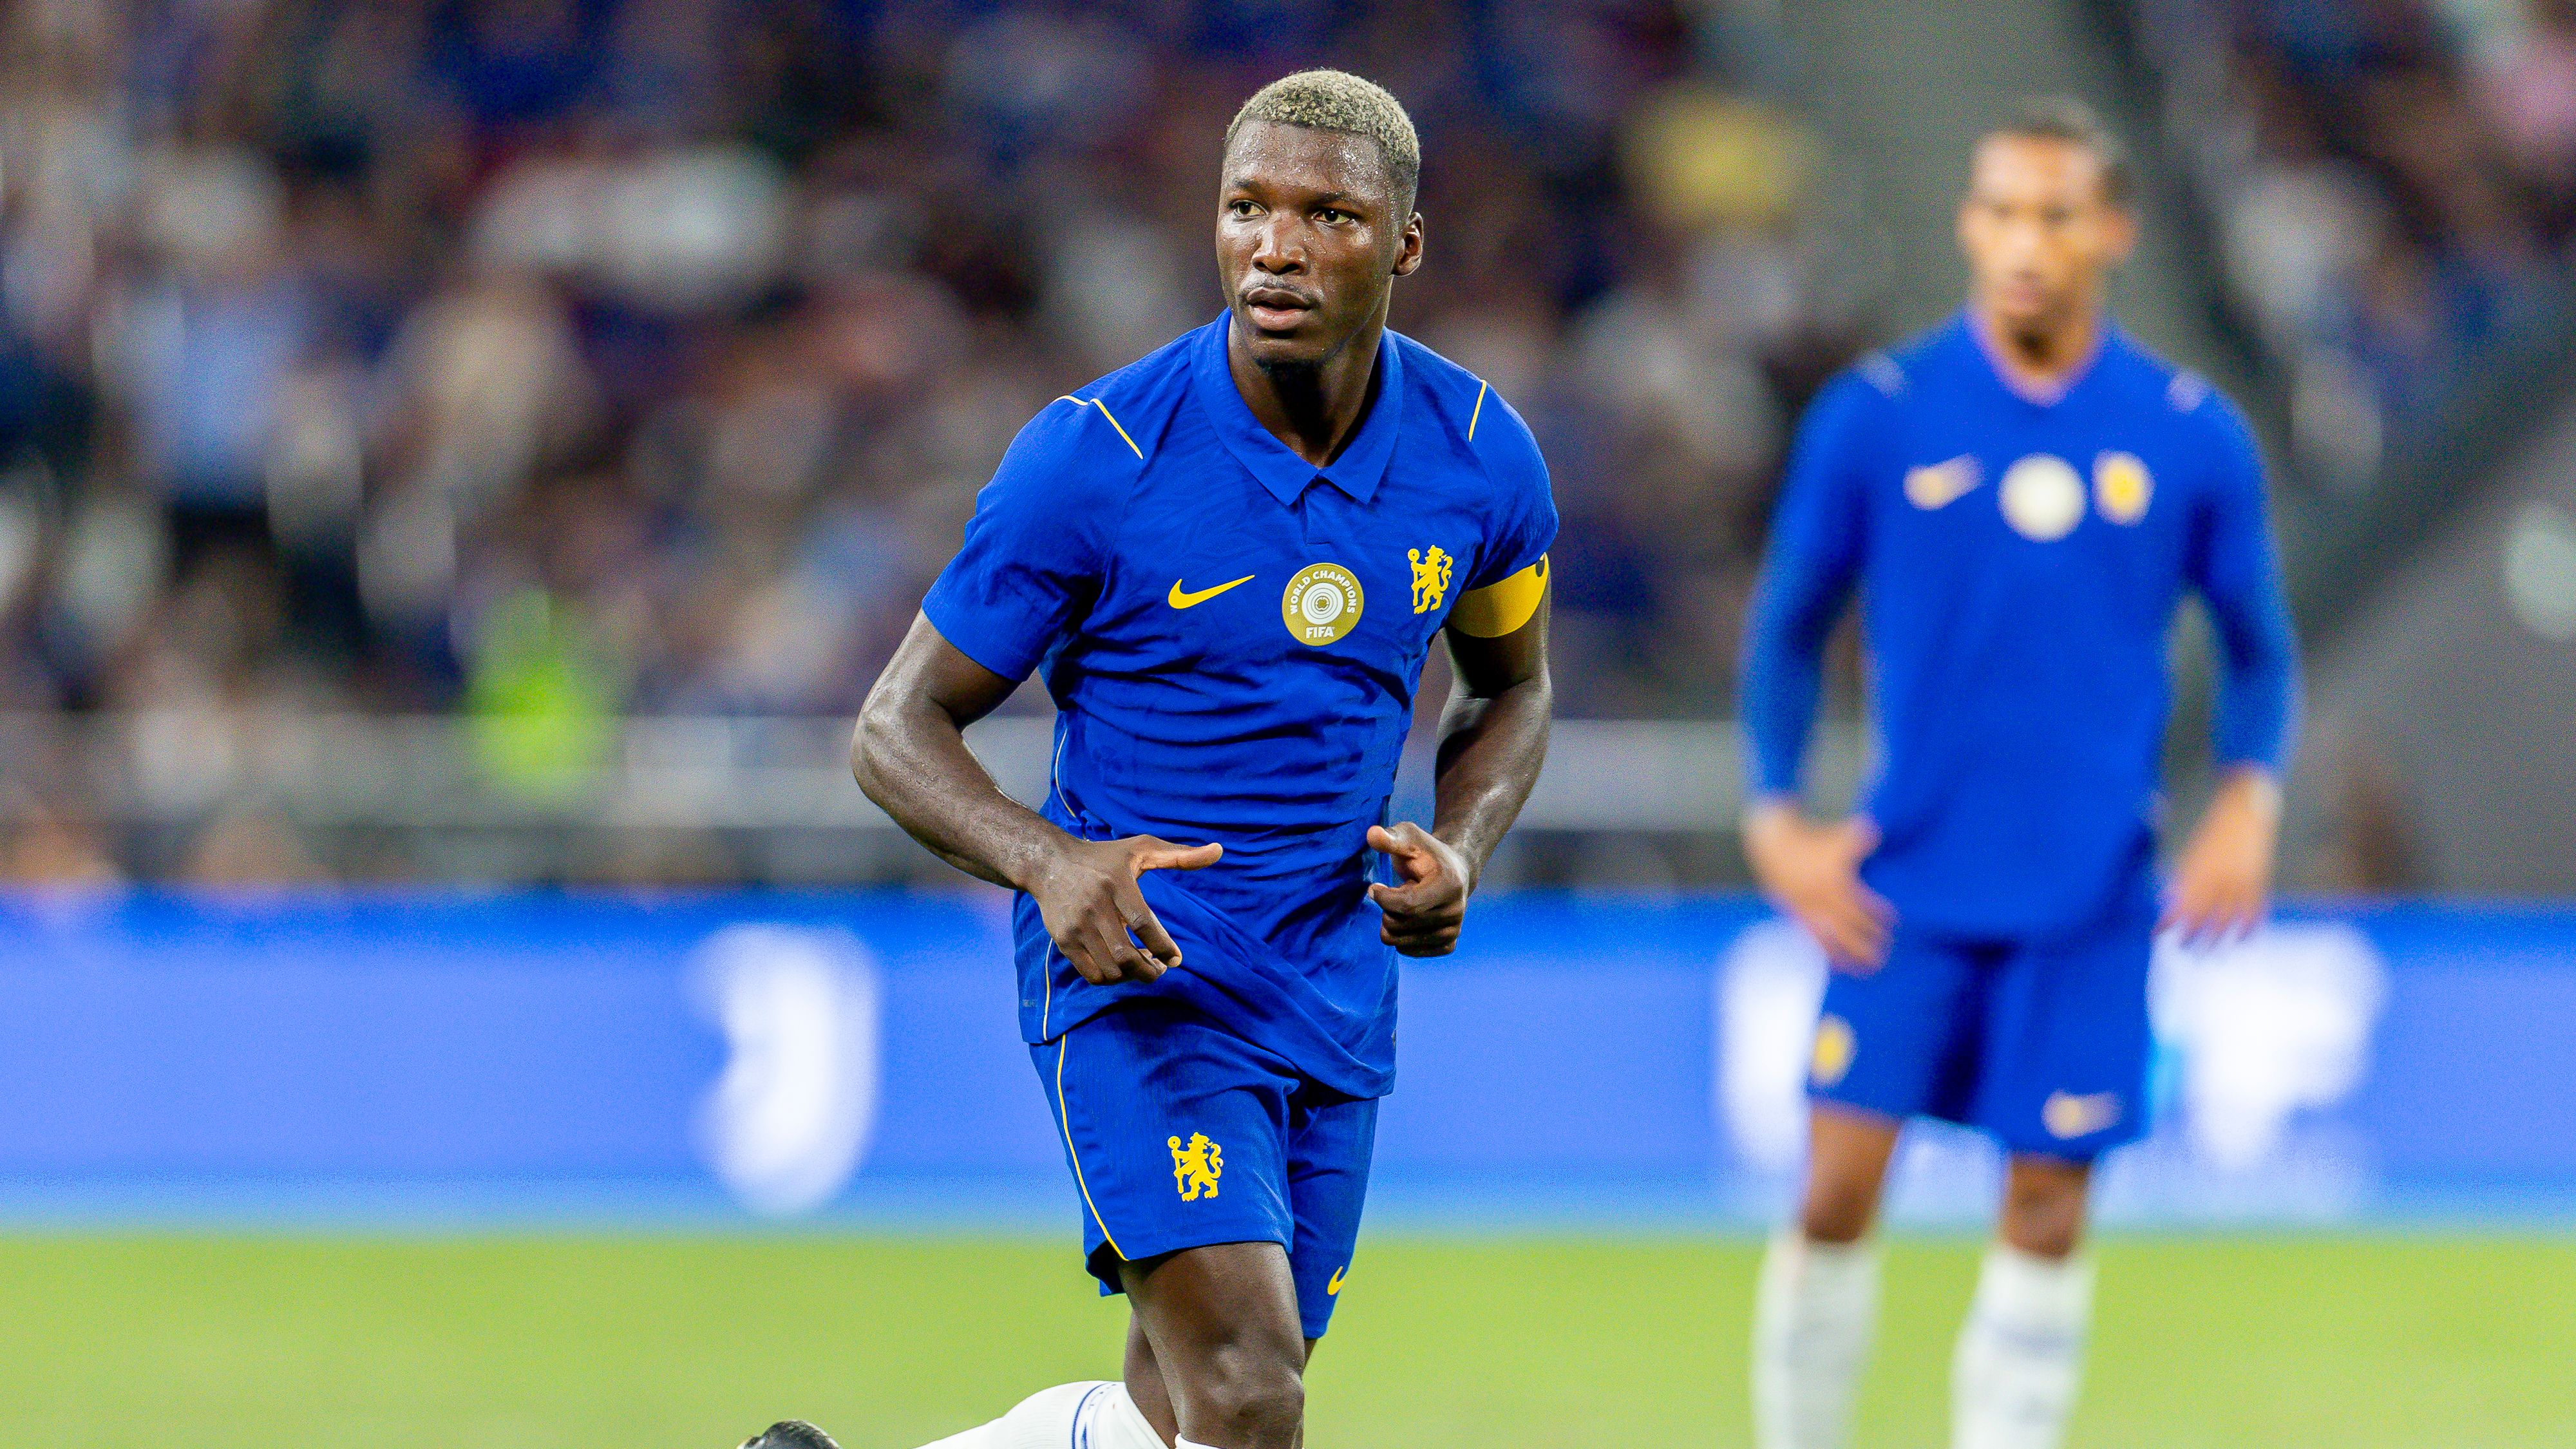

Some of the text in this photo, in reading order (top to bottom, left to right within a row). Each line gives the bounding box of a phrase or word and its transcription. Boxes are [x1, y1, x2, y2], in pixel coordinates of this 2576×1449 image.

[1290, 570, 1357, 615] WORLD CHAMPIONS
[1306, 627, 1334, 639] FIFA
